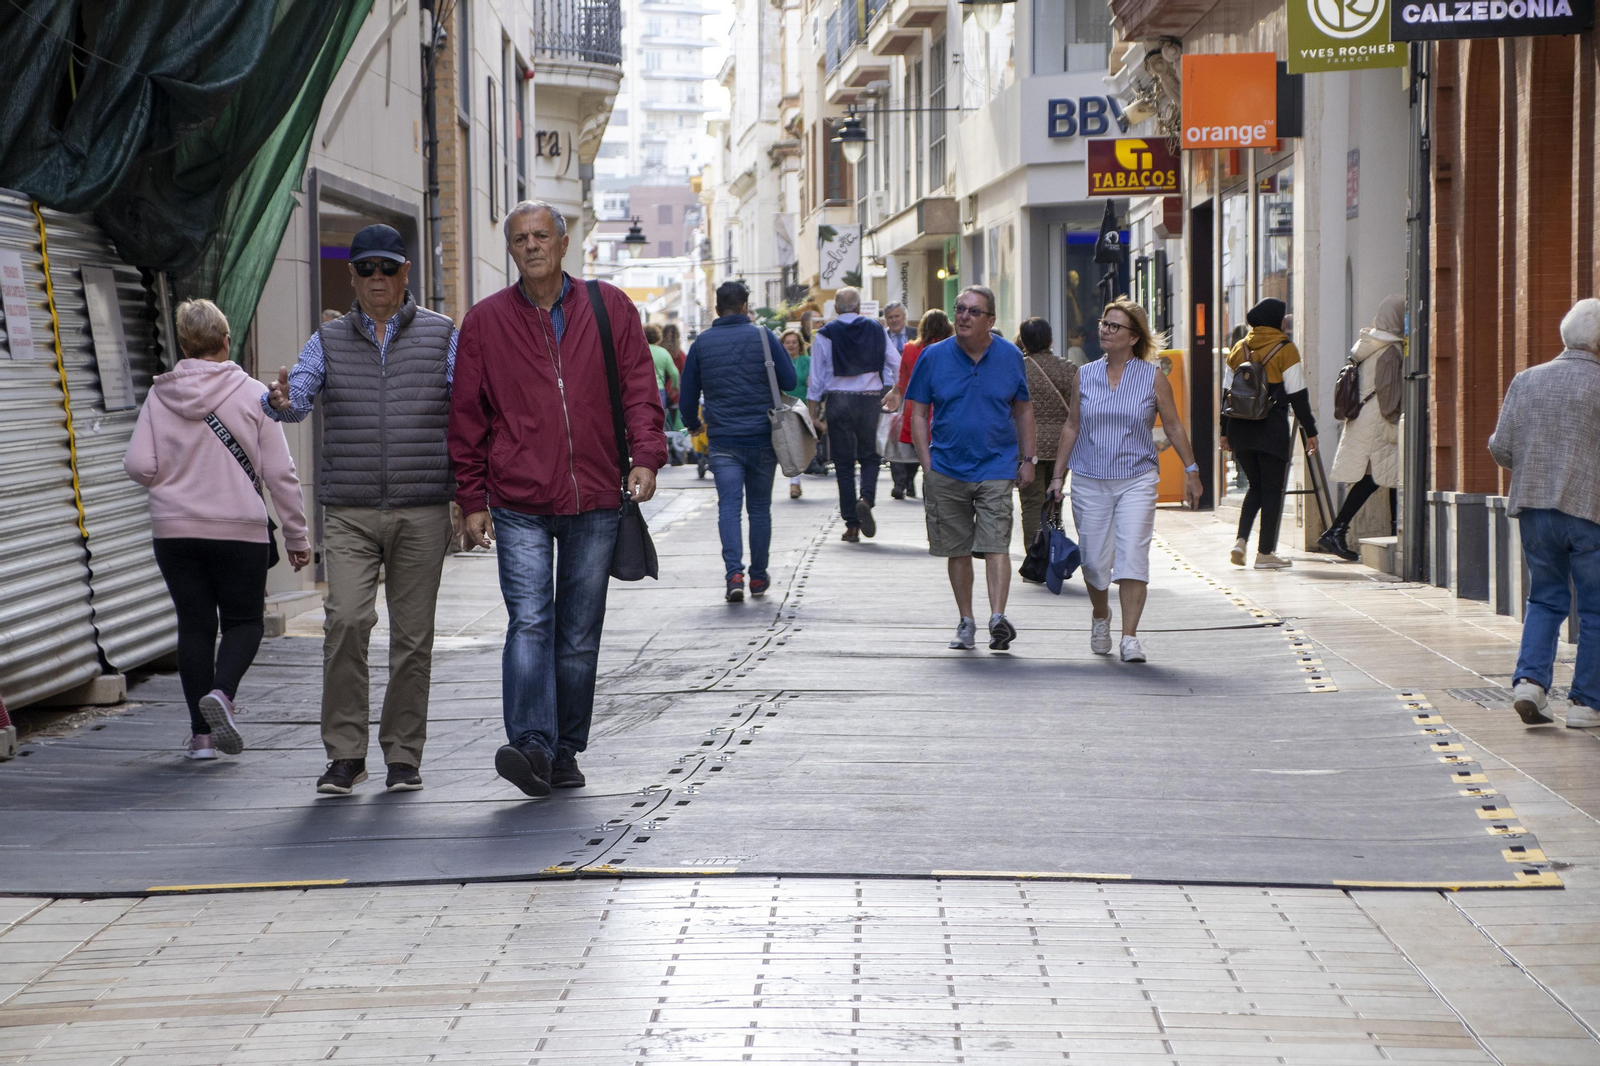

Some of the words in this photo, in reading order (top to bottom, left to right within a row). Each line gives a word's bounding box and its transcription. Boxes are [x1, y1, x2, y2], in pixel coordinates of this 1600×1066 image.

[1402, 0, 1573, 23] CALZEDONIA
[1300, 47, 1335, 58] YVES
[1339, 43, 1396, 56] ROCHER
[1327, 56, 1370, 64] FRANCE
[1186, 123, 1267, 145] orange
[1092, 169, 1177, 188] TABACOS
[229, 442, 246, 458] MY
[240, 457, 256, 477] LIFE
